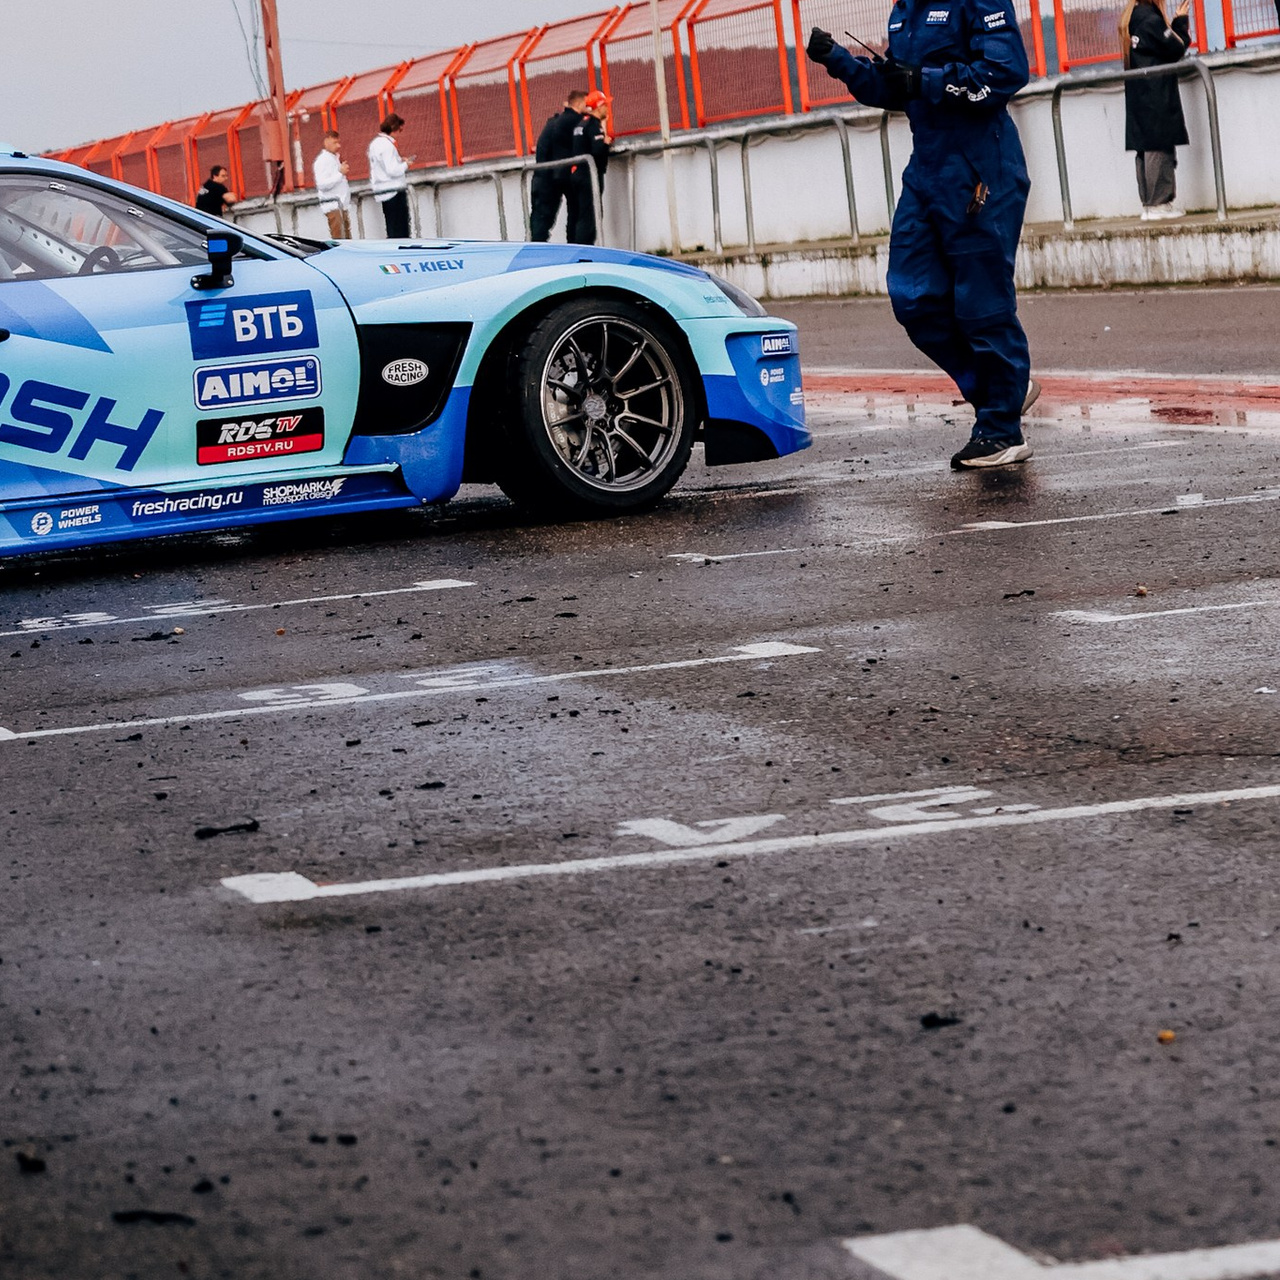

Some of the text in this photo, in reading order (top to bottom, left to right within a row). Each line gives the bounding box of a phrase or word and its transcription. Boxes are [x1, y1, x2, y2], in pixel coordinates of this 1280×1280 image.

[984, 11, 1005, 22] DRIFT
[401, 259, 464, 273] T. KIELY
[232, 304, 304, 342] ВТБ
[388, 362, 422, 373] FRESH
[201, 366, 315, 401] AIMOL
[387, 371, 423, 383] RACING
[217, 415, 303, 444] RDS TV
[227, 440, 294, 457] RDSTV.RU
[263, 480, 332, 498] SHOPMARKA
[132, 491, 243, 516] freshracing.ru
[263, 493, 308, 505] motorsport
[60, 504, 99, 519] POWER
[58, 514, 102, 529] WHEELS
